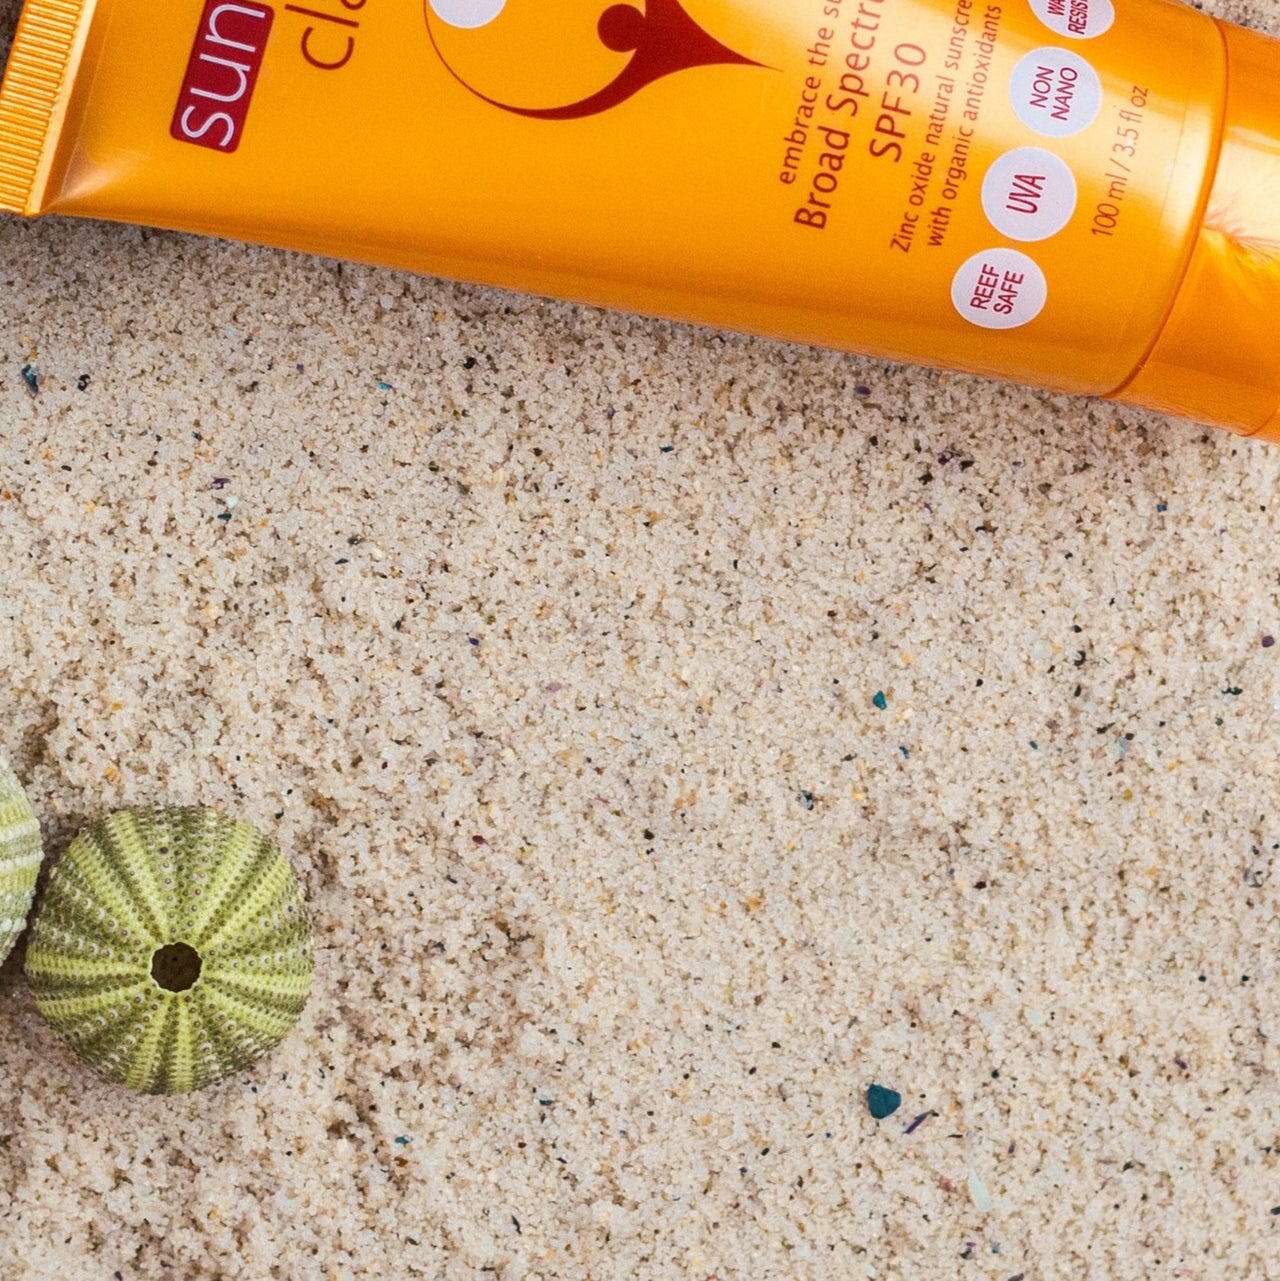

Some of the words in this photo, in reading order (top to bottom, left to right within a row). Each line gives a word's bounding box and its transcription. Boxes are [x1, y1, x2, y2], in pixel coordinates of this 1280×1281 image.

[780, 76, 821, 184] embrace
[808, 27, 834, 66] the
[870, 42, 927, 162] SPF30
[1029, 66, 1054, 108] NON
[1050, 67, 1078, 120] NANO
[1130, 85, 1148, 108] oz
[927, 206, 952, 246] with
[942, 126, 974, 200] organic
[963, 4, 1002, 121] antioxidants
[1119, 109, 1143, 123] fl
[1112, 125, 1139, 157] 3.5
[794, 126, 851, 229] Broad
[890, 212, 919, 253] Zinc
[909, 152, 936, 207] oxide
[925, 75, 955, 145] natural
[1109, 158, 1131, 172] /
[1006, 174, 1046, 214] UVA
[1105, 172, 1128, 201] ml
[1091, 203, 1120, 237] 100
[970, 264, 1000, 310] REEF
[993, 270, 1024, 314] SAFE
